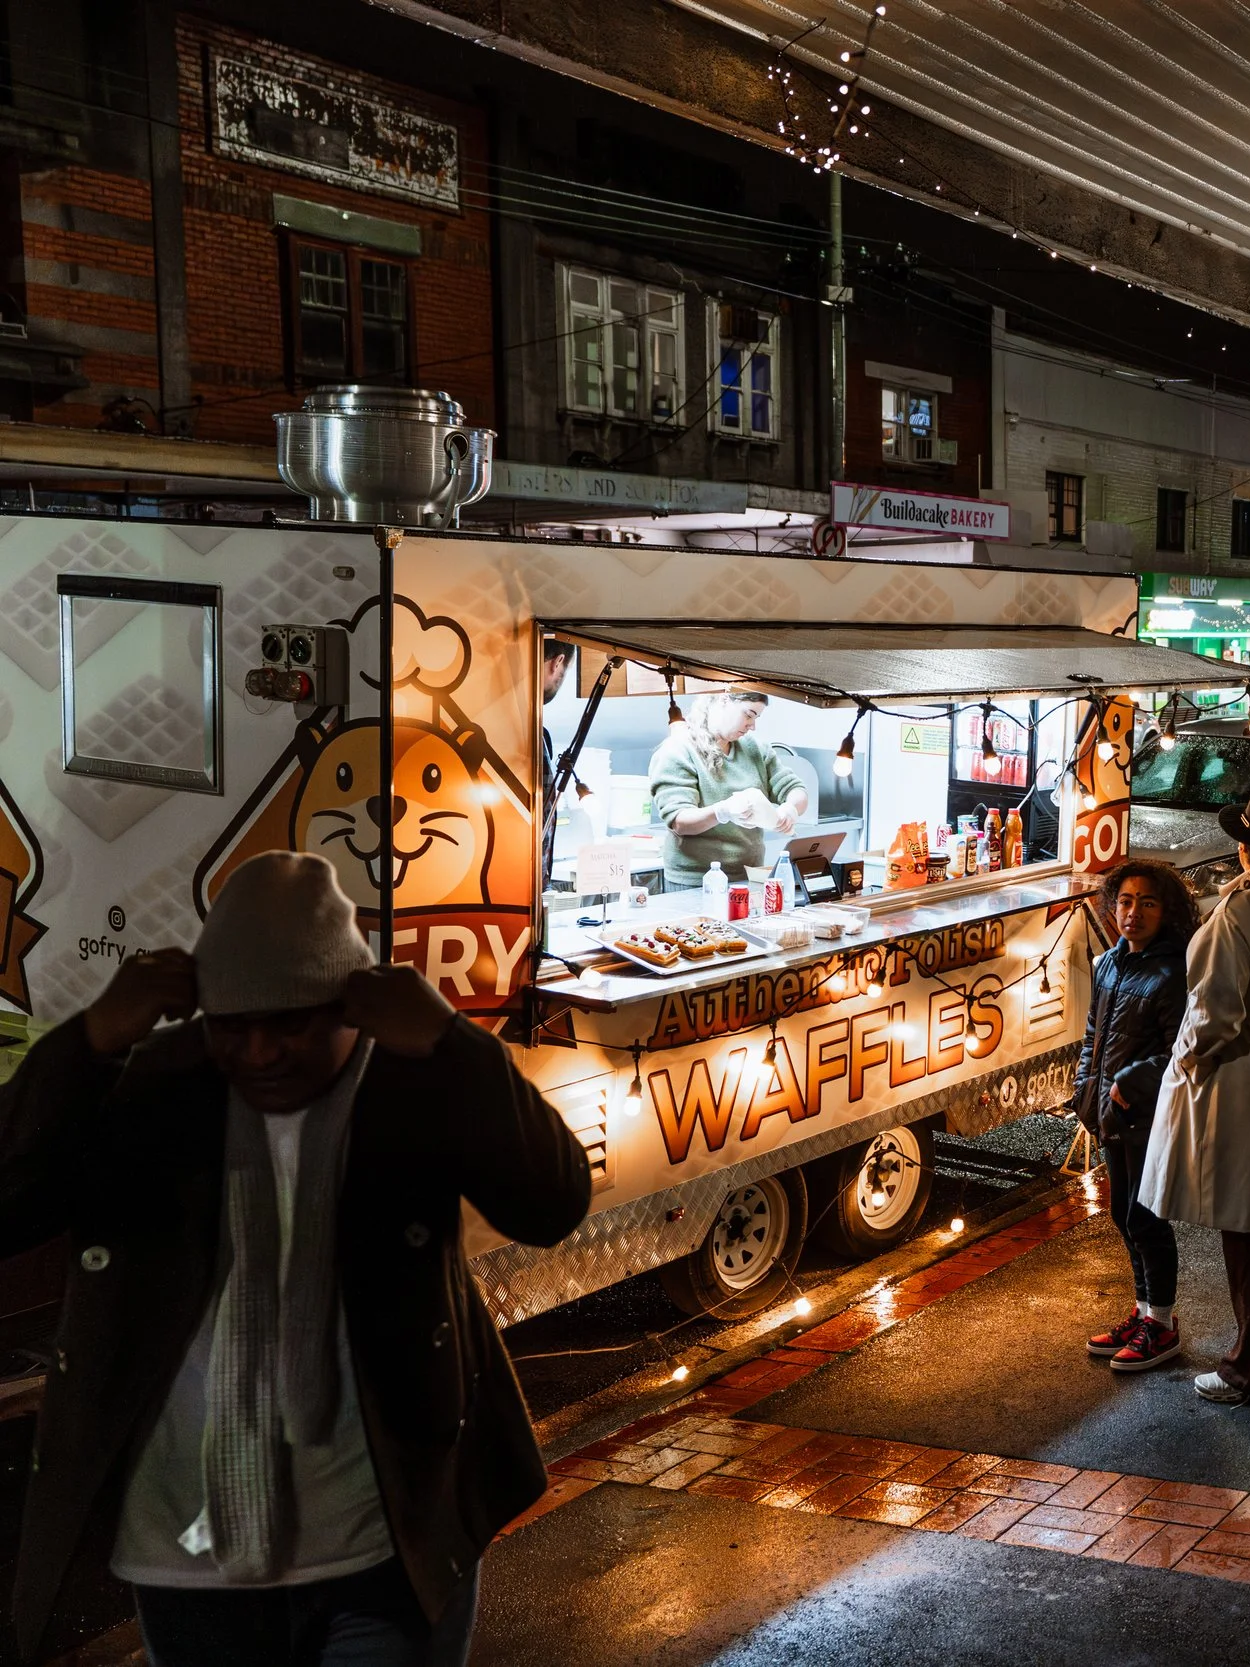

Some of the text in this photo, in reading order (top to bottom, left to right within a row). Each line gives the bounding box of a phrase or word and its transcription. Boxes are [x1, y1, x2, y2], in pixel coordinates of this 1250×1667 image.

[881, 498, 994, 529] Buildacake BAKERY
[1168, 577, 1217, 597] SUBWAY
[609, 863, 624, 877] $15
[646, 918, 1006, 1051] Authentic Polish
[648, 973, 1005, 1166] WAFFLES
[1027, 1062, 1079, 1097] gofry.
